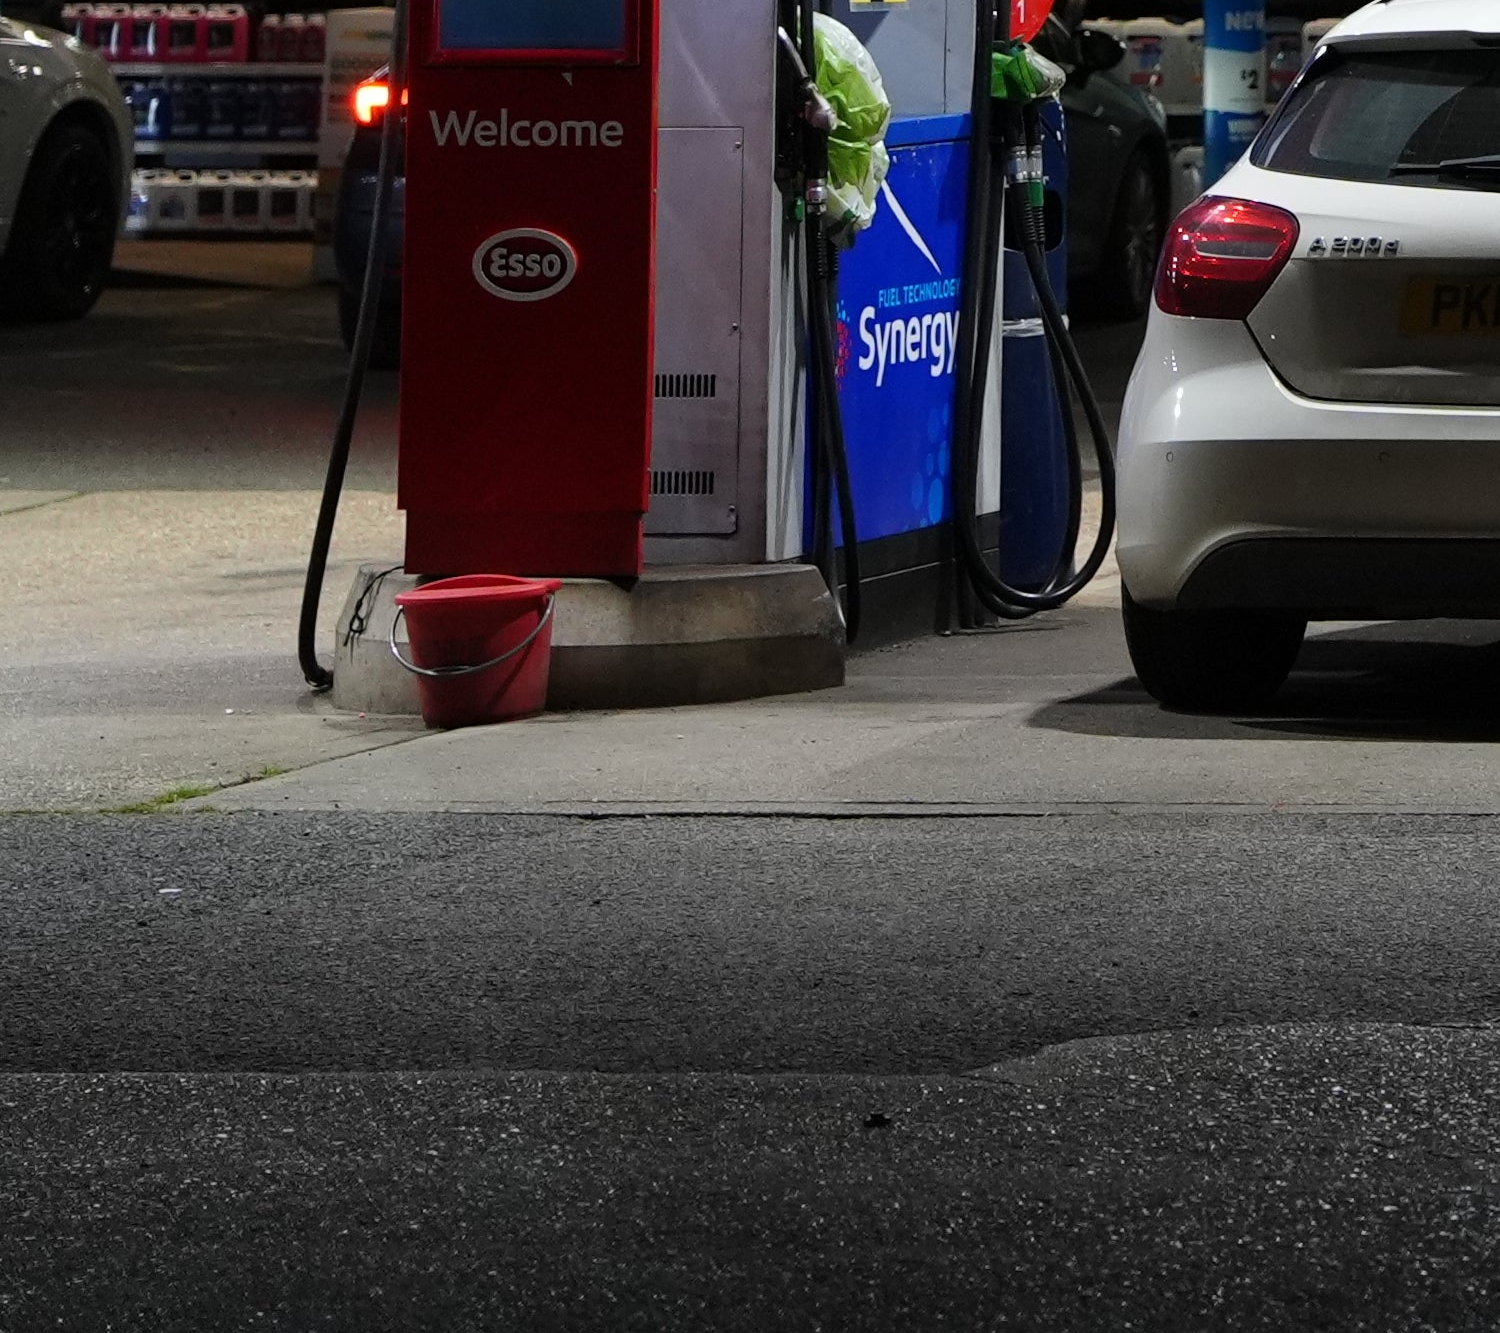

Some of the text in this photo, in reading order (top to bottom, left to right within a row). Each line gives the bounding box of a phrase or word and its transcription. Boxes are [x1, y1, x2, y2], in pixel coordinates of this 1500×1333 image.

[428, 107, 625, 148] Welcome
[489, 246, 562, 278] Esso
[878, 287, 901, 309] FUEL
[858, 305, 961, 388] Synergy
